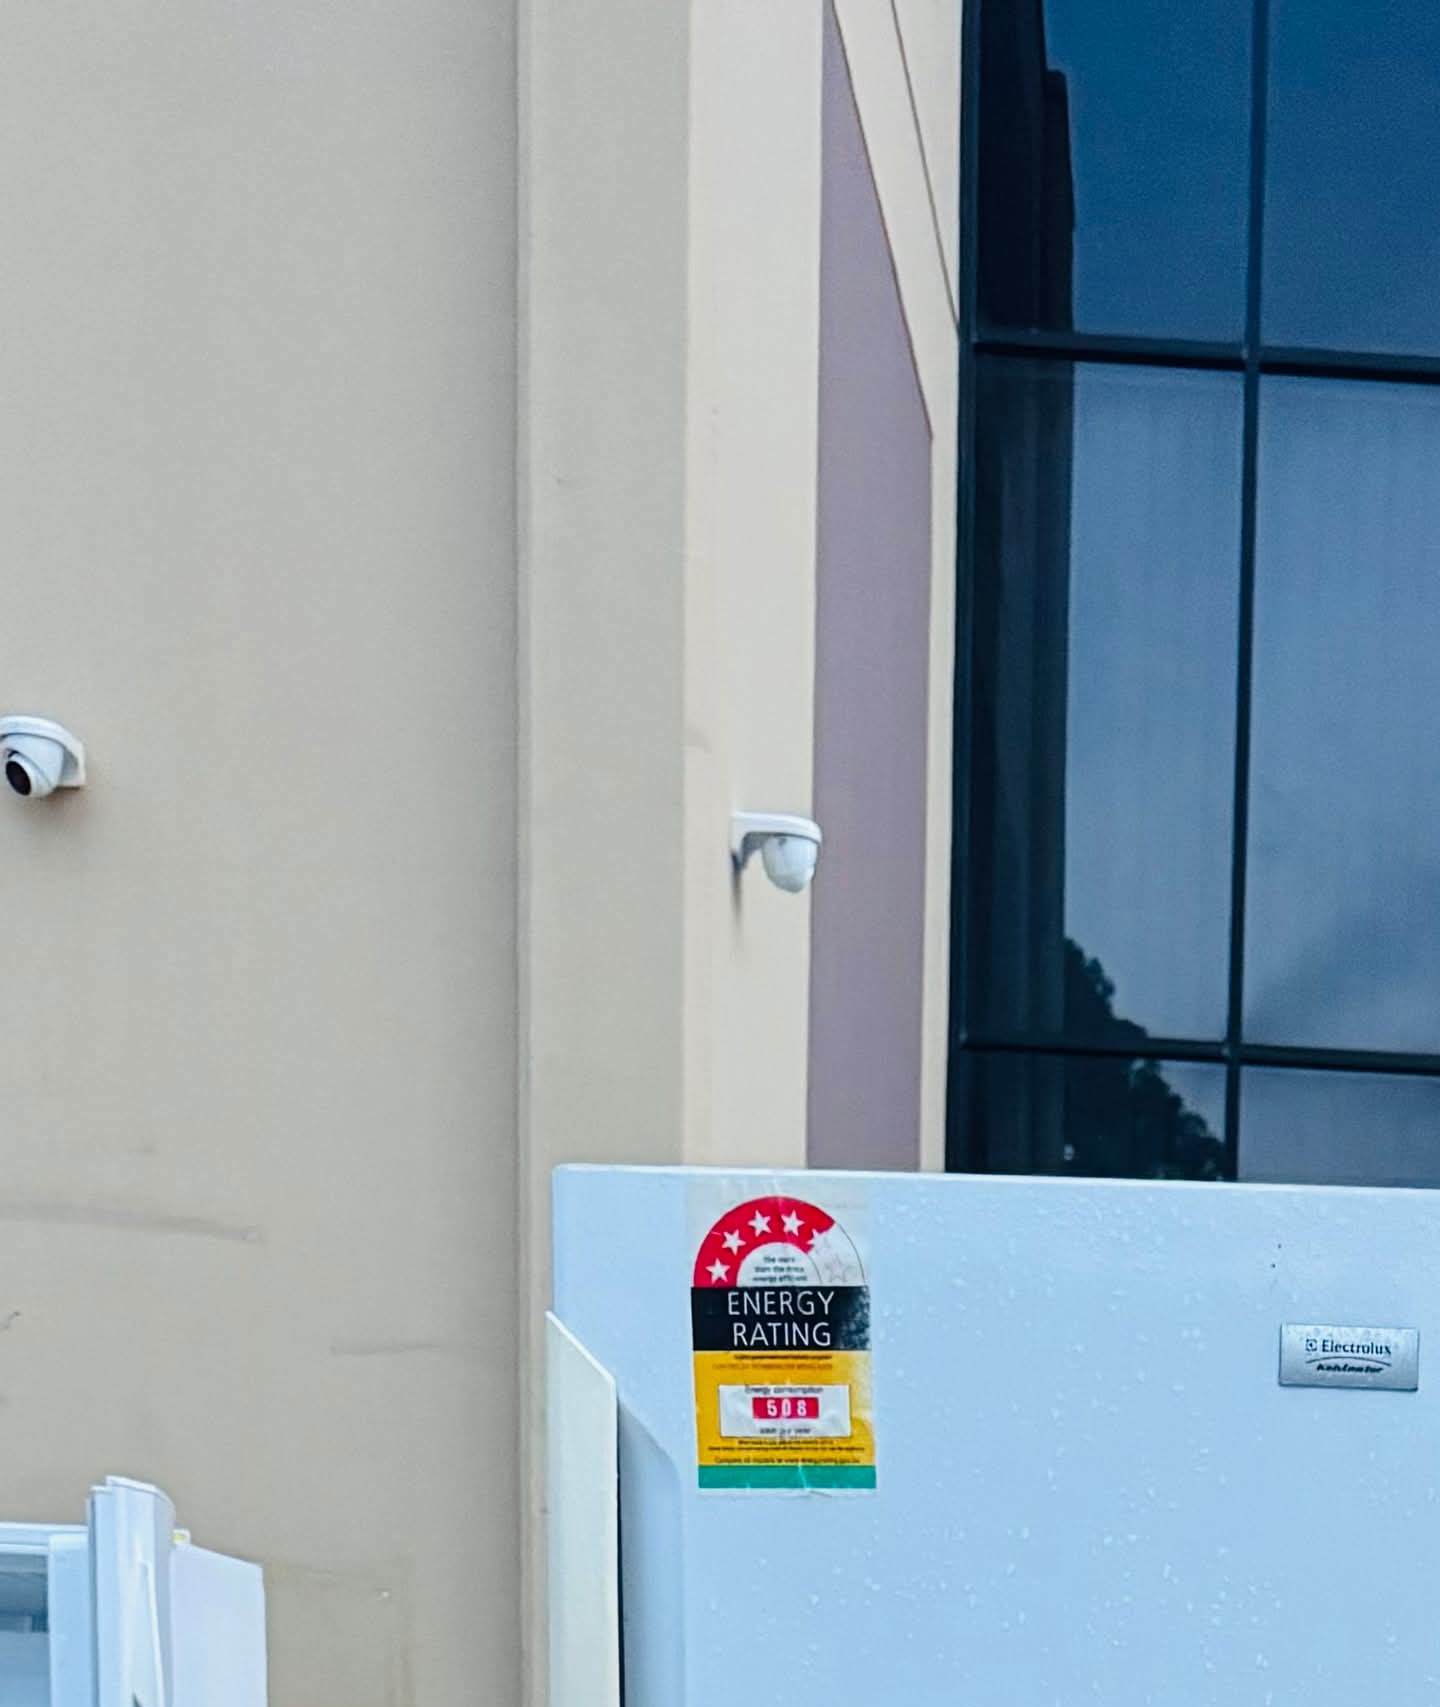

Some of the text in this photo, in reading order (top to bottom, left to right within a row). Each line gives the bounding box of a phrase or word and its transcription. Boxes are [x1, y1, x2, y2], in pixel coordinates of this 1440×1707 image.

[727, 1290, 834, 1315] ENERGY
[733, 1321, 831, 1346] RATING
[1322, 1339, 1392, 1355] Electrolux
